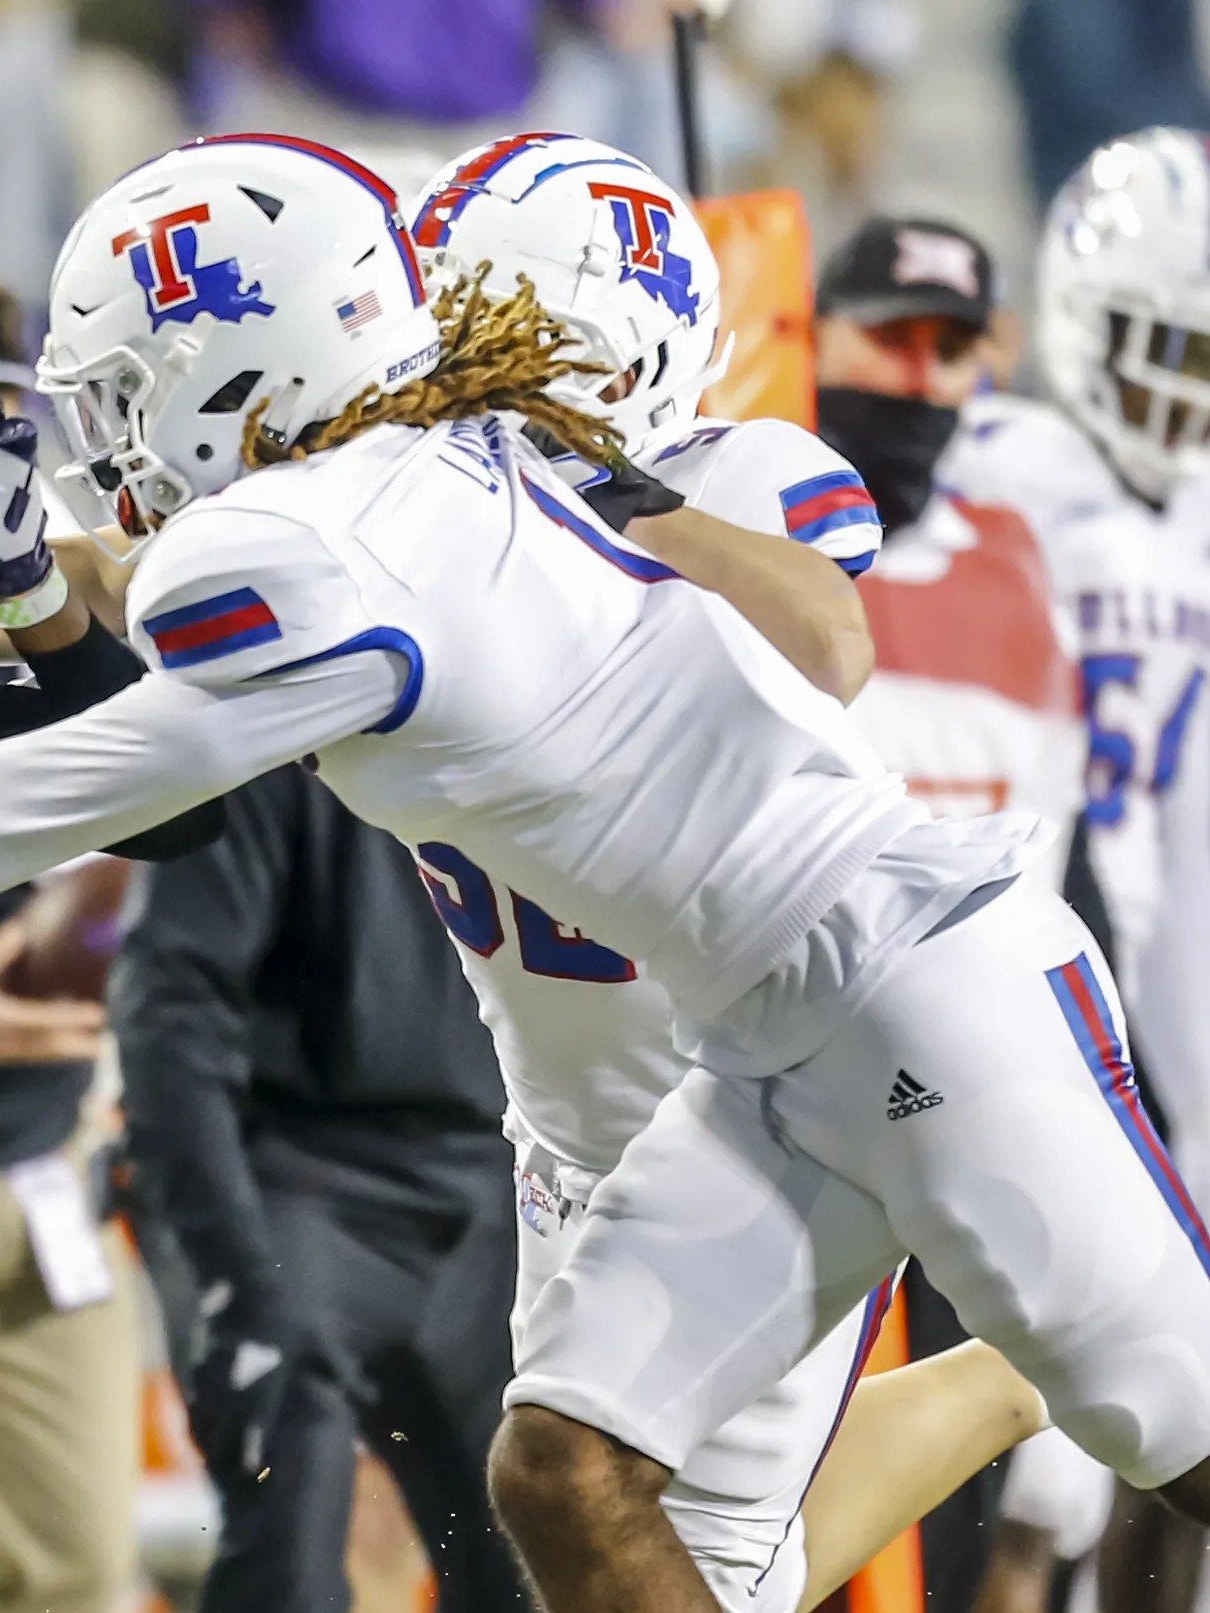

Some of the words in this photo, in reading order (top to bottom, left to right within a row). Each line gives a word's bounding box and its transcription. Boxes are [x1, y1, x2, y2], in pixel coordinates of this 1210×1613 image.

[112, 203, 211, 306] T
[587, 182, 676, 272] T
[887, 1092, 943, 1121] adidas
